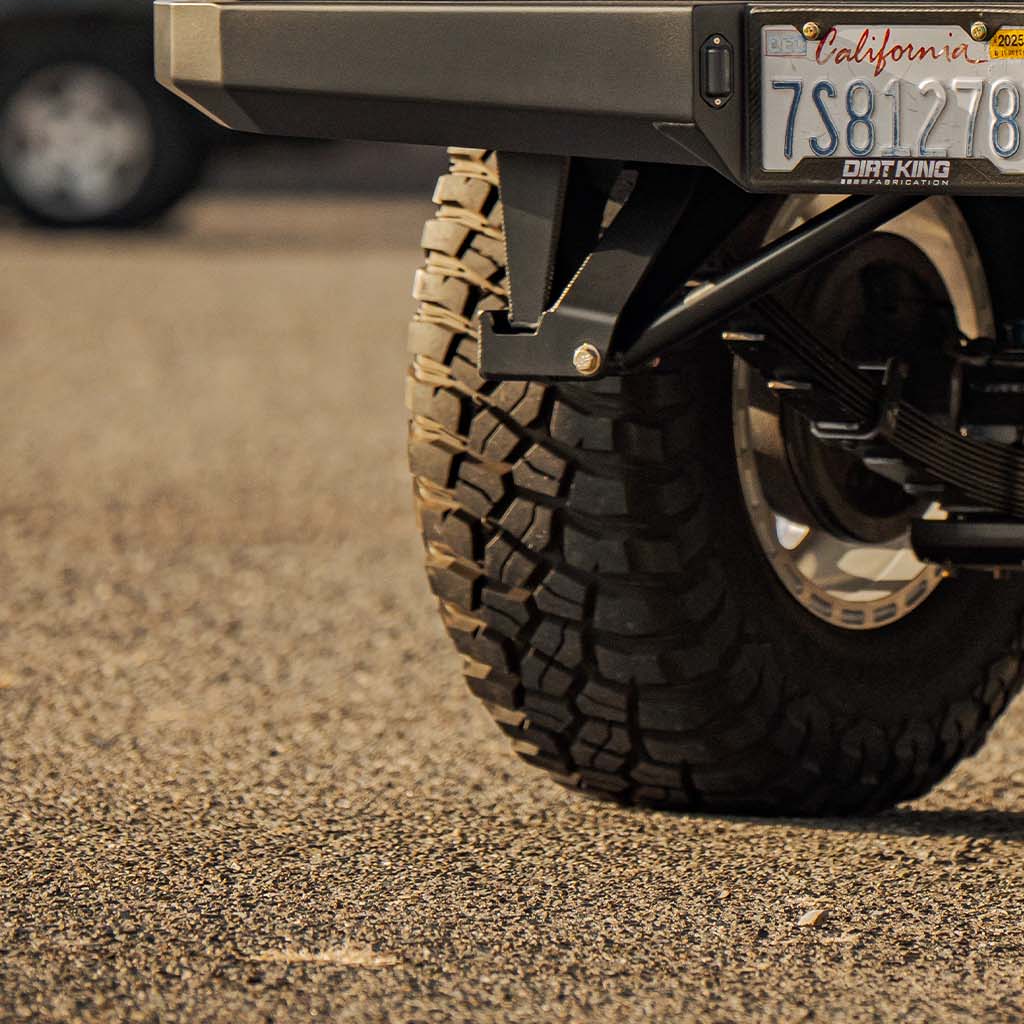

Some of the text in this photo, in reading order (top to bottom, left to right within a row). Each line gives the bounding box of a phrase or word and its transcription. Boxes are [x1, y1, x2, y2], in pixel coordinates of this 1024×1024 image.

[998, 34, 1024, 47] 2025
[815, 27, 988, 77] California
[772, 78, 1020, 159] 7S81278
[842, 159, 951, 179] DIRT KING
[868, 178, 949, 186] FABRICATION
